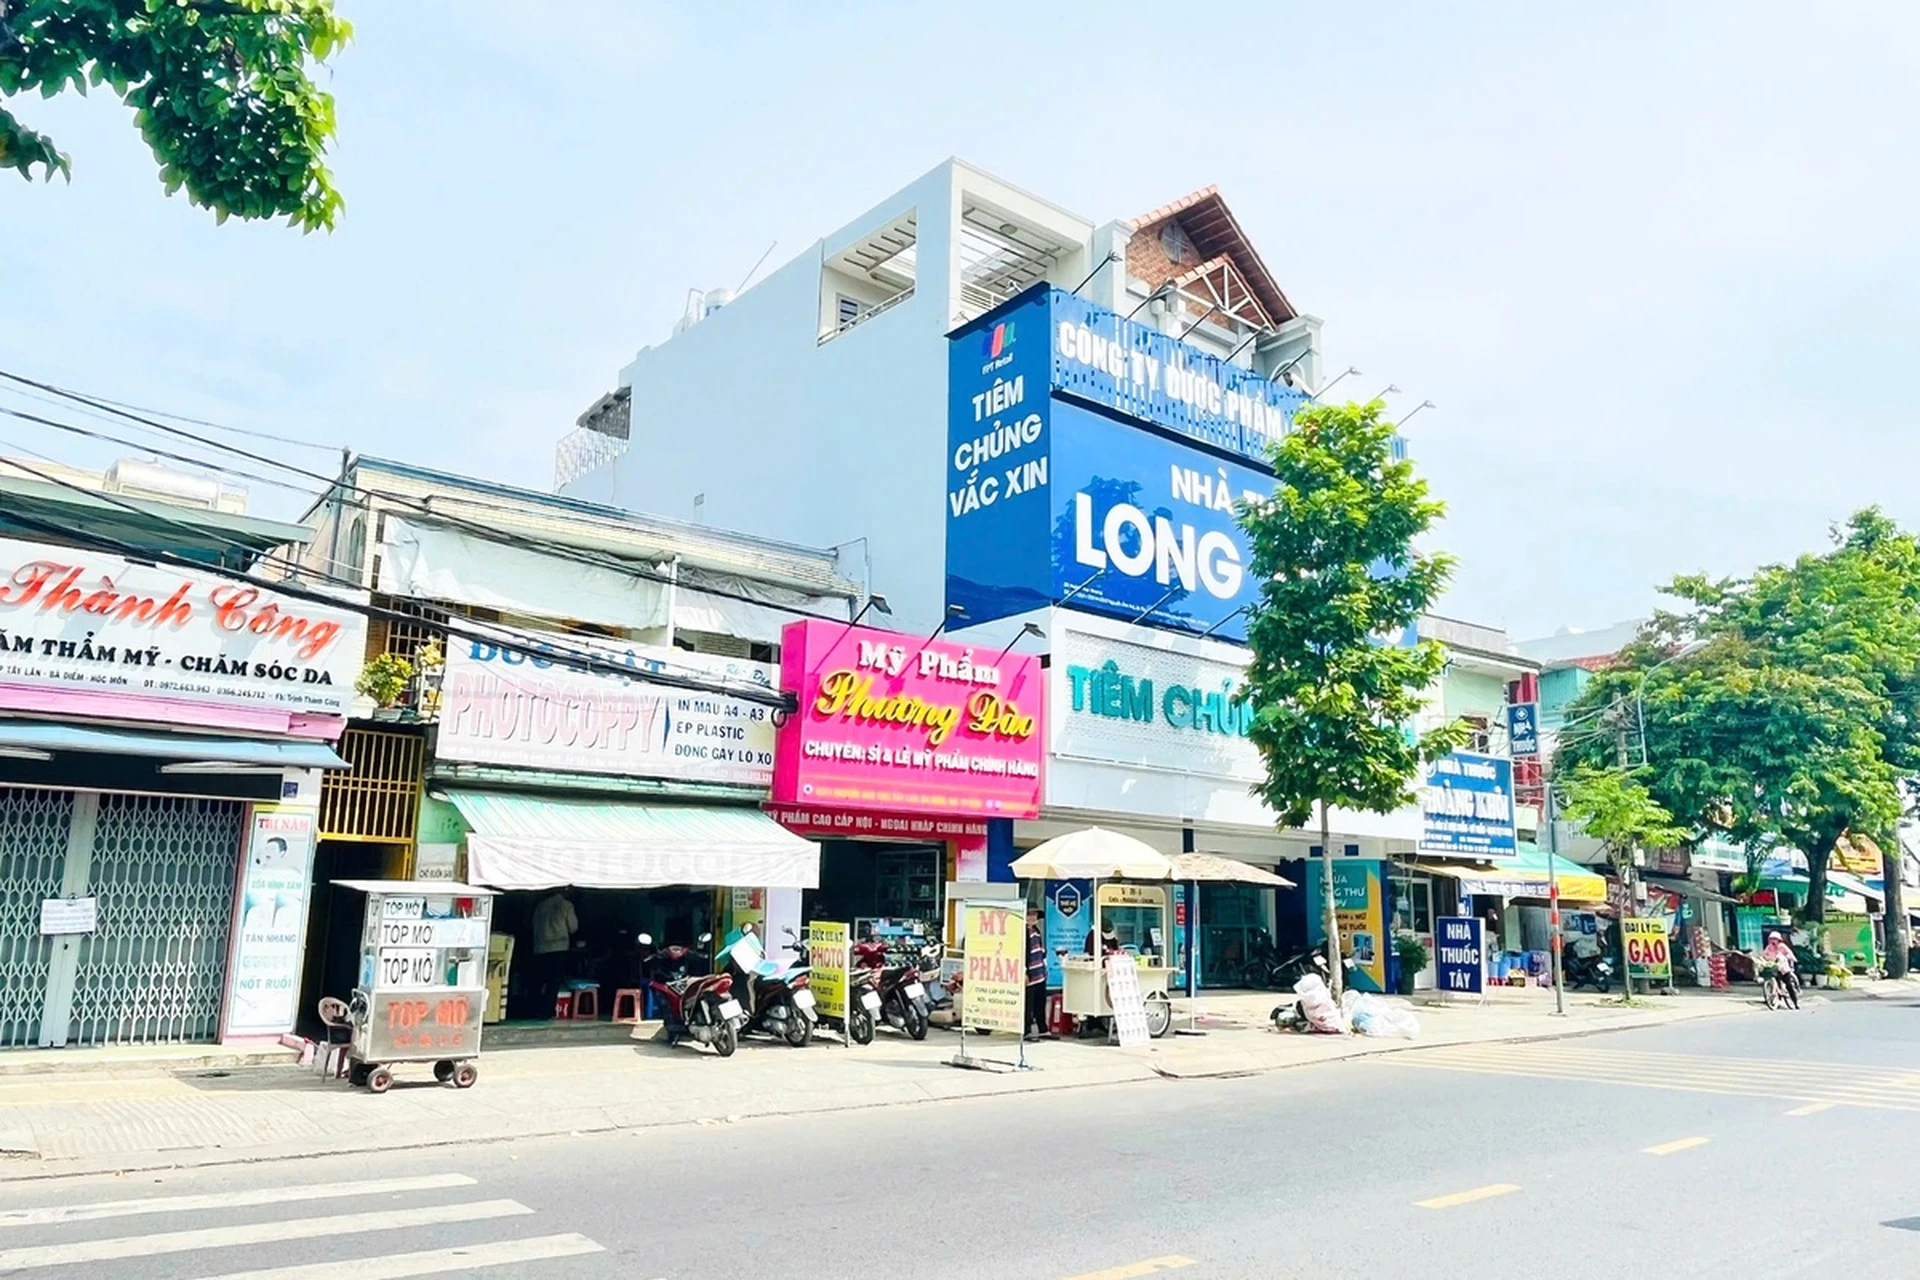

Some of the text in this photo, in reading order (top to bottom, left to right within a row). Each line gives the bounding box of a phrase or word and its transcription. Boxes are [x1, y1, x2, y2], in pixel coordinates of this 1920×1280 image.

[994, 351, 1014, 370] Retail
[1059, 320, 1123, 378] CÔNG
[1131, 351, 1160, 390] TY
[972, 375, 1024, 422] TIÊM
[954, 413, 1042, 472] CHỦNG
[949, 456, 1048, 518] VẮC XIN
[1171, 464, 1235, 515] NHÀ
[1075, 491, 1243, 600] LONG
[0, 559, 342, 660] Thành Công
[41, 630, 117, 662] THẨM
[122, 645, 161, 667] MỸ
[180, 653, 249, 677] CHĂM
[254, 659, 297, 681] SÓC
[302, 667, 333, 686] DA
[858, 639, 1000, 685] Mỹ Phẩm
[815, 669, 960, 746] Phương
[968, 692, 1036, 738] Đào
[1066, 658, 1154, 723] TIÊM
[448, 670, 660, 753] PHOTOCOPPY
[678, 698, 690, 711] IN
[724, 704, 738, 717] A4
[750, 708, 764, 720] A3
[696, 724, 744, 740] PLASTIC
[1512, 718, 1535, 753] NHÀ THUỐC
[758, 752, 772, 765] XO
[882, 749, 892, 762] &
[914, 749, 934, 767] MỸ
[935, 750, 969, 770] PHẨM
[971, 755, 1007, 774] CHÍNH
[1007, 759, 1039, 777] HÀNG
[1437, 757, 1497, 780] NHÀ THUỐC
[781, 809, 810, 825] PHẨM
[812, 813, 832, 826] CAO
[834, 812, 854, 827] CẤP
[856, 815, 873, 829] NỘI
[1474, 785, 1510, 821] KHÔI
[1446, 920, 1471, 940] NHÀ
[811, 946, 844, 969] PHOTO
[1441, 943, 1479, 965] THUỐC
[1449, 968, 1471, 989] TÂY
